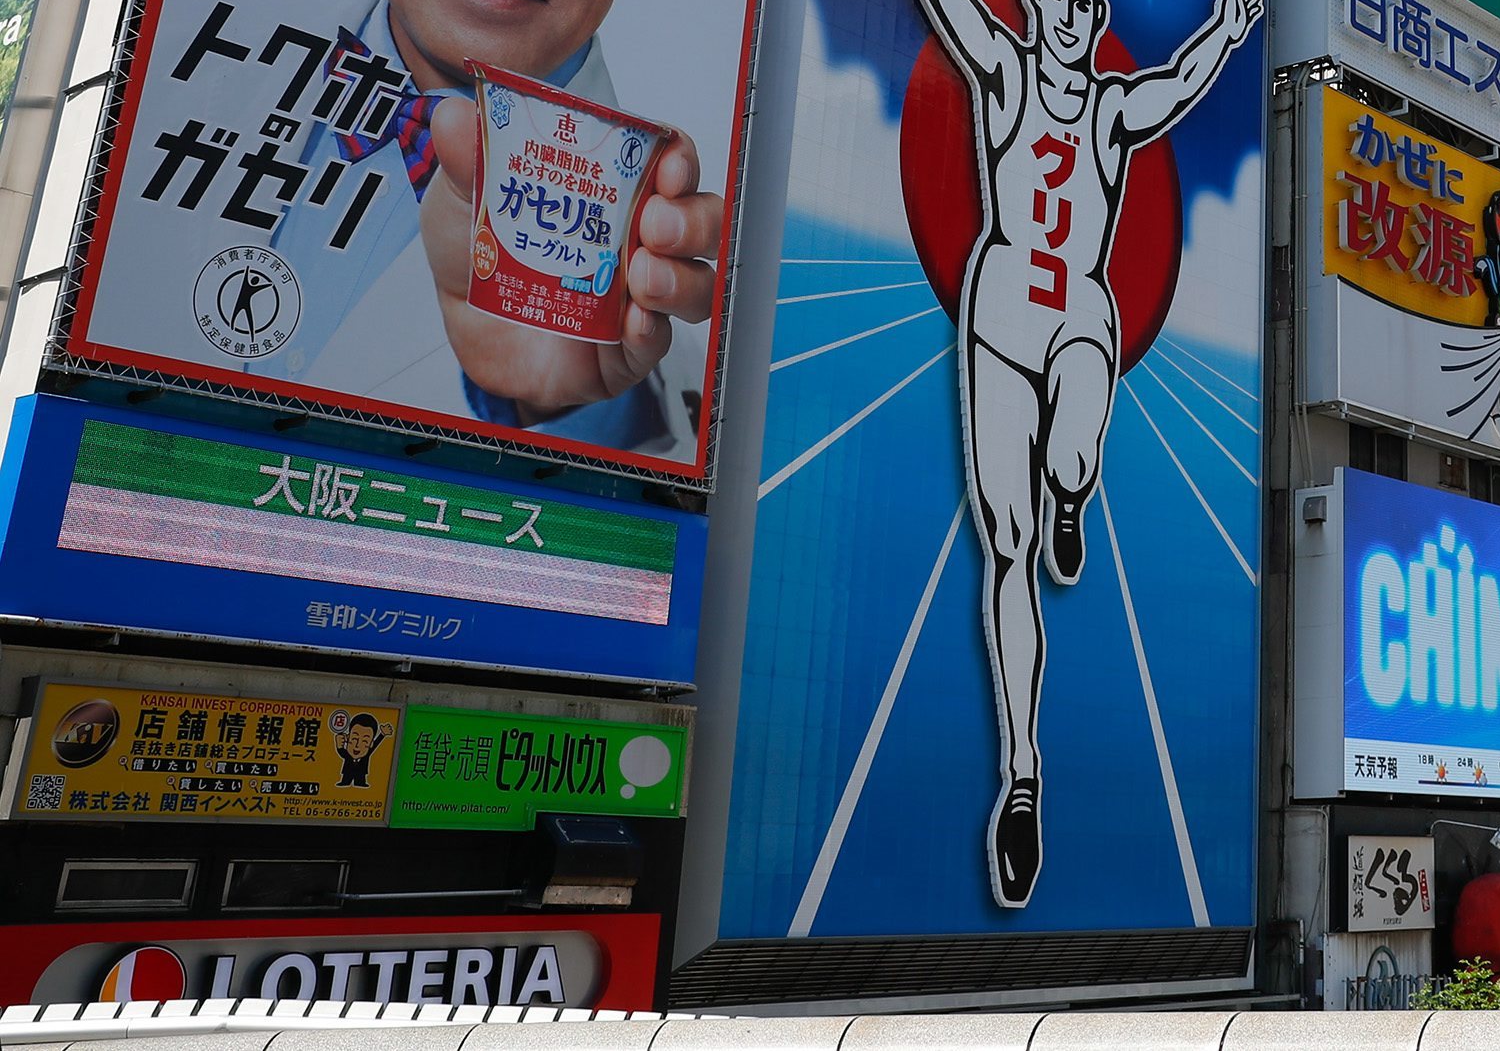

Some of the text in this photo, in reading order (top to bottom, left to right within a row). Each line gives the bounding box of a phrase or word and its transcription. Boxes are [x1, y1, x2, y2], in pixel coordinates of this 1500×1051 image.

[170, 0, 412, 137] トクホ
[257, 112, 302, 143] の
[552, 112, 584, 145] 恵
[523, 139, 604, 180] 内臓脂肪を
[1350, 113, 1466, 204] かぜに
[140, 118, 386, 250] ガセリ
[507, 152, 618, 205] 減らすのを助ける
[496, 175, 586, 235] ガセリ
[1028, 130, 1081, 313] グリコ
[514, 230, 587, 267] ヨーグルト
[1340, 172, 1478, 298] 改源
[213, 248, 293, 285] 消費者庁許可
[501, 299, 583, 332] はっ酵乳 100g
[199, 314, 286, 356] 特定保健用食品
[252, 454, 545, 549] 大阪ニュース
[305, 599, 462, 642] 雪印メグミルク
[139, 693, 324, 718] KANSAI INVEST CORPORATION
[133, 707, 322, 749] 店舗情報館
[130, 740, 317, 763] 居抜き店舗総合プロデュース
[132, 759, 197, 773] 借りたい
[215, 762, 279, 776] 買いたい
[410, 727, 609, 796] 賃貸・売買 ピタットハウス
[1353, 753, 1399, 781] 天気予報
[1417, 754, 1435, 766] 18時
[1456, 757, 1474, 769] 24時
[68, 789, 277, 815] 株式会社 関西インベスト
[179, 777, 243, 792] 貸したい
[260, 781, 320, 795] 売りたい
[282, 807, 382, 819] TEL 06-6766-2016
[401, 800, 511, 815] http://www.pitat.com/
[209, 943, 566, 1006] LOTTERIA
